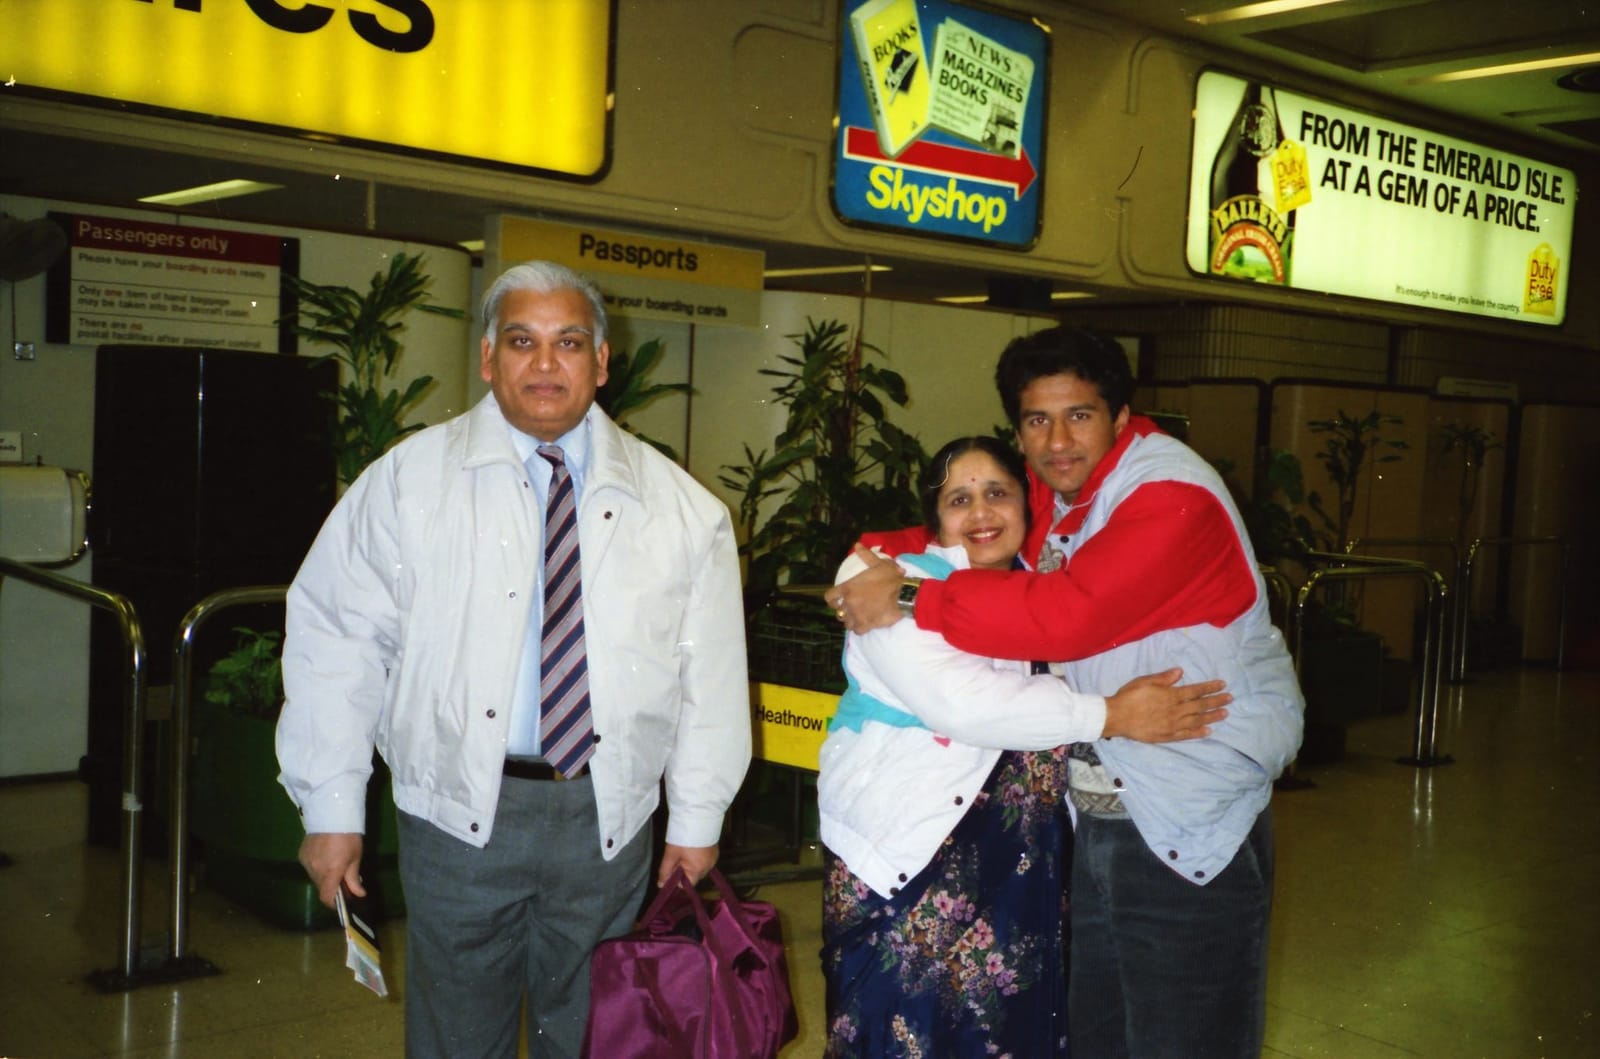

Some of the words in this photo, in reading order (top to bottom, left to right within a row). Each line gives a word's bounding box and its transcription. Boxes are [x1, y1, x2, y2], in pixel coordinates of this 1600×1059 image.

[873, 23, 918, 63] BOOKS
[968, 36, 1012, 74] NEWS
[939, 68, 989, 106] BOOKS
[942, 49, 1024, 104] MAGAZINES
[1299, 110, 1370, 157] FROM
[1376, 129, 1418, 168] THE
[1423, 141, 1521, 192] EMERALD
[1525, 167, 1565, 205] ISLE.
[866, 165, 1007, 233] Skyshop
[1320, 158, 1352, 191] AT
[1353, 165, 1371, 197] A
[1377, 169, 1429, 208] GEM
[1434, 182, 1461, 214] OF
[1463, 190, 1479, 220] A
[1483, 193, 1540, 232] PRICE.
[79, 220, 185, 248] Passengers
[190, 235, 228, 254] only
[579, 234, 698, 272] Passports
[79, 252, 112, 264] Please
[115, 256, 138, 266] have
[166, 261, 208, 275] boarding
[210, 266, 236, 276] cards
[1531, 259, 1556, 284] Duty
[79, 285, 101, 297] Only
[617, 297, 642, 308] your
[645, 297, 694, 316] boarding
[697, 305, 727, 318] cards
[1529, 279, 1553, 300] Free
[754, 704, 823, 732] Heathrow
